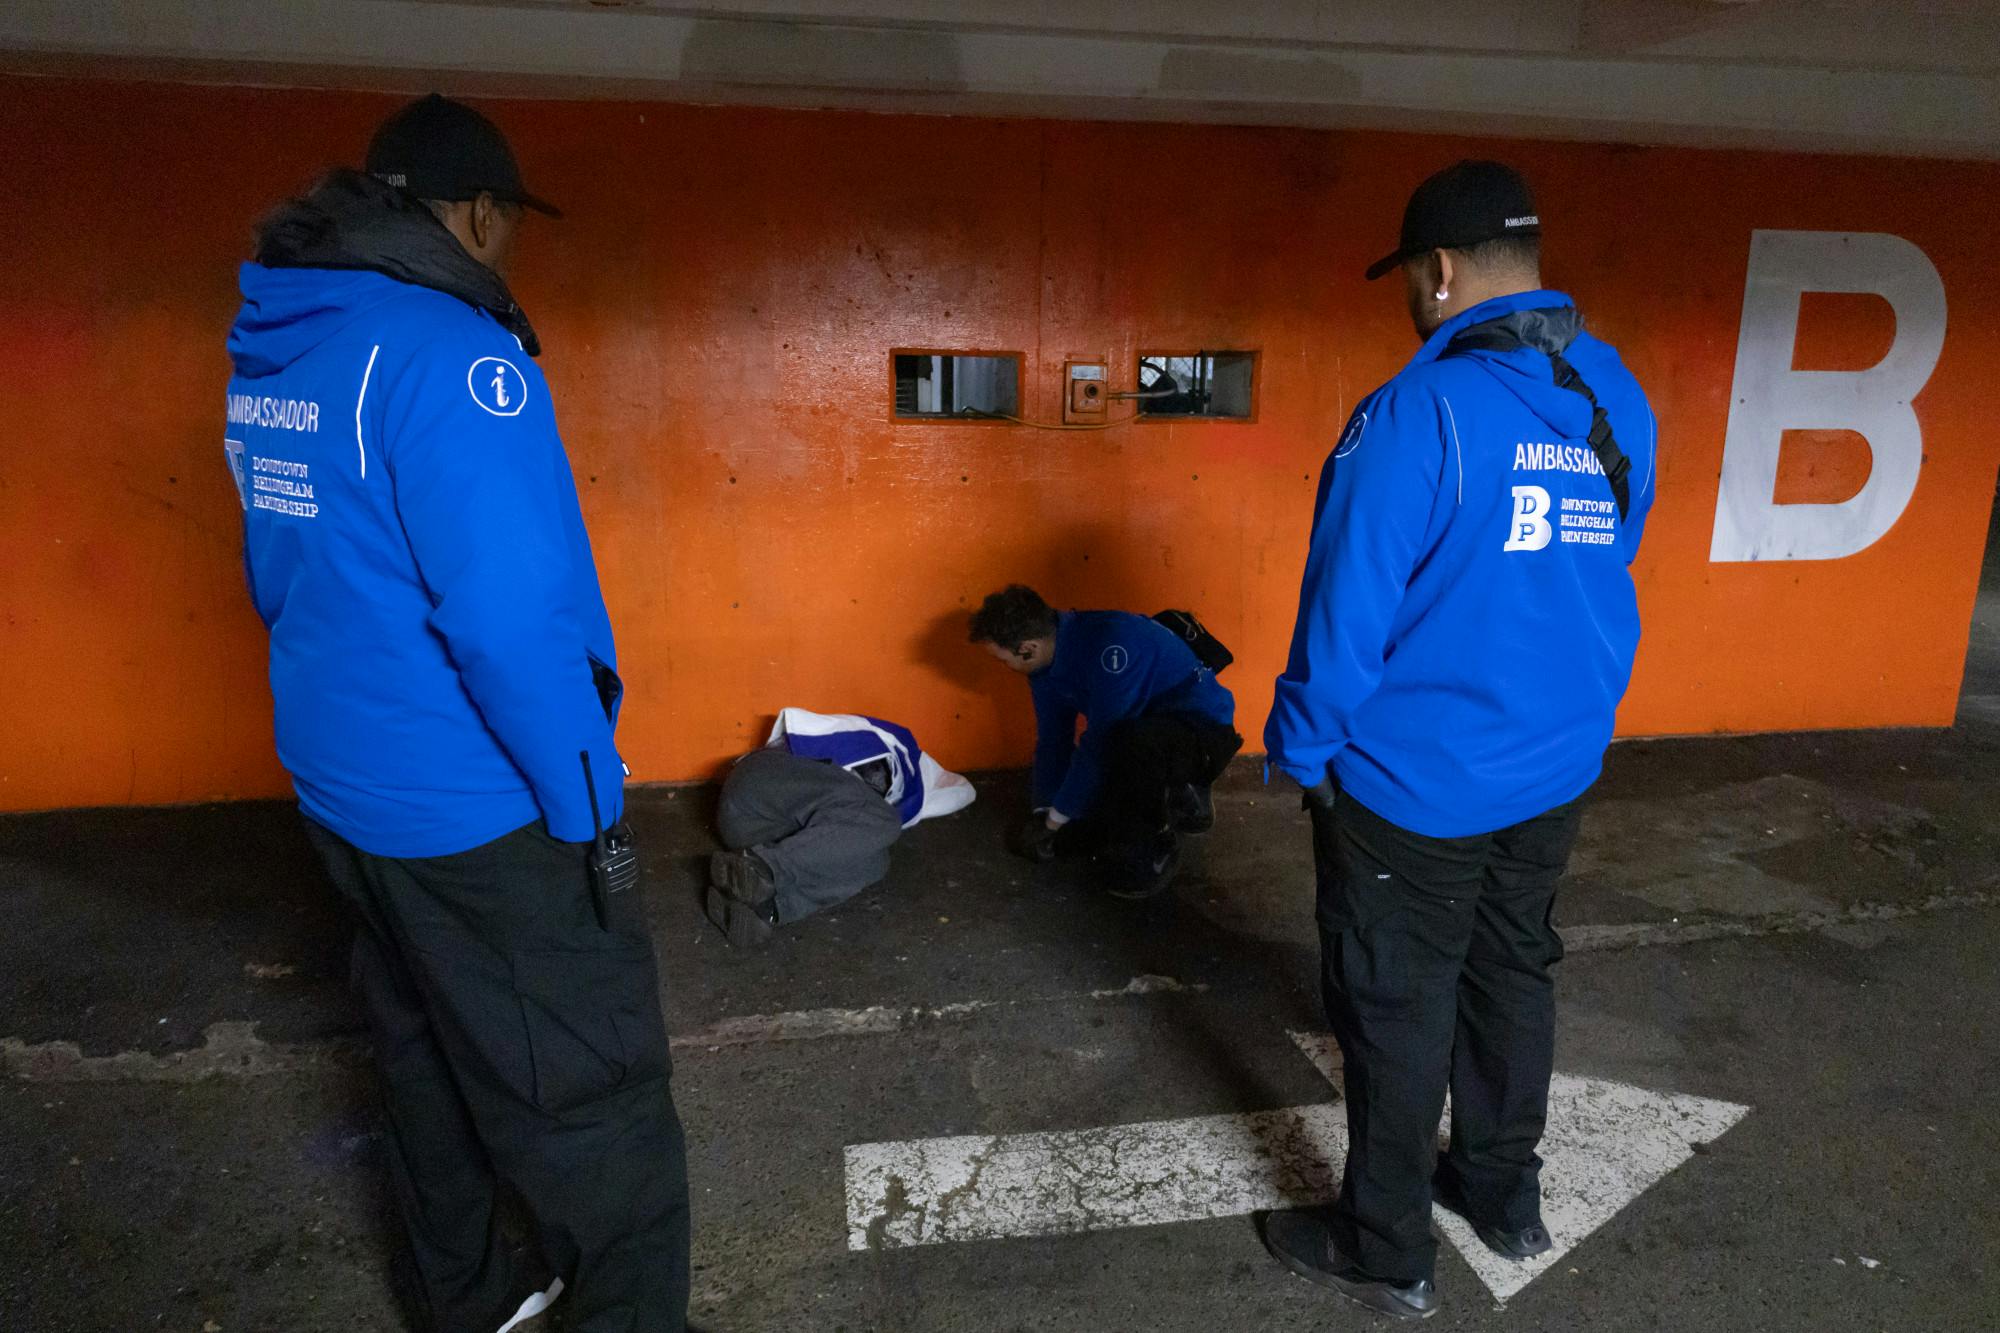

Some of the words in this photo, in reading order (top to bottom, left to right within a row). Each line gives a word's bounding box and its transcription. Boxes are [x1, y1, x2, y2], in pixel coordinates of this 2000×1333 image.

[227, 394, 319, 432] AMBASSADOR
[1709, 229, 1948, 562] B
[1513, 443, 1606, 476] AMBASSAD
[1504, 485, 1552, 552] B
